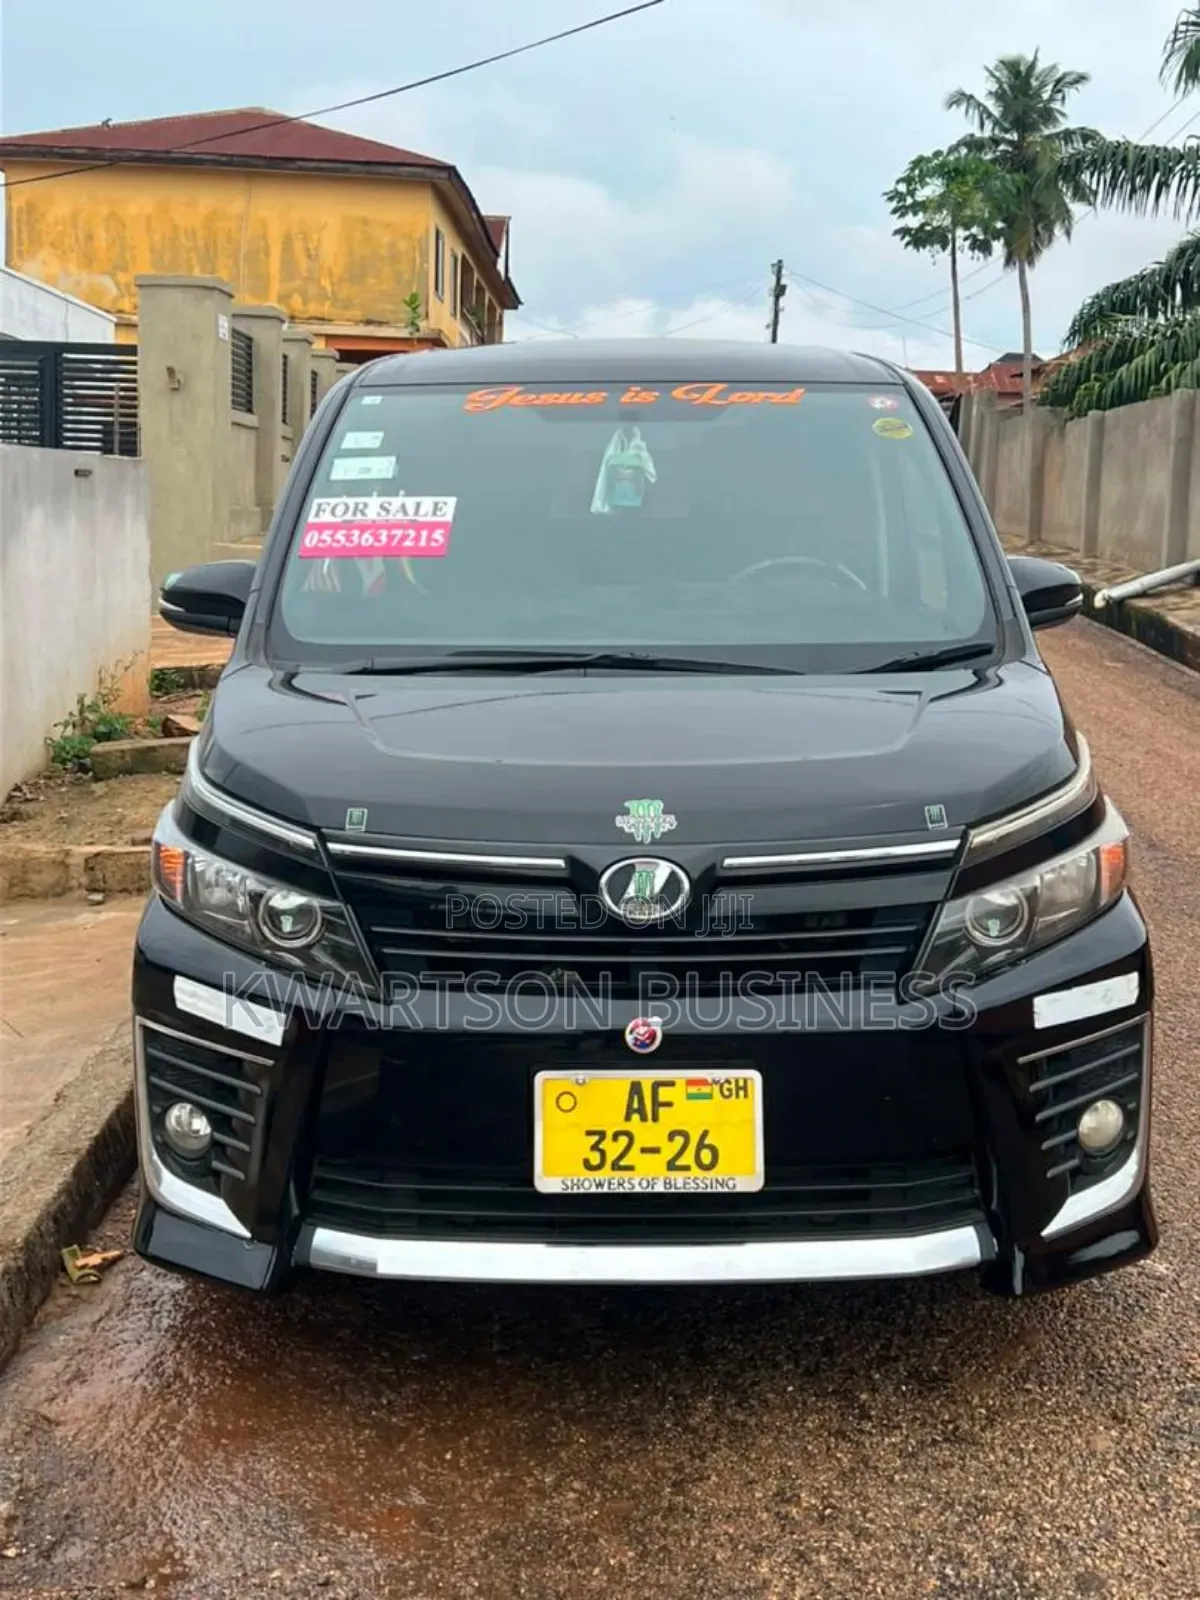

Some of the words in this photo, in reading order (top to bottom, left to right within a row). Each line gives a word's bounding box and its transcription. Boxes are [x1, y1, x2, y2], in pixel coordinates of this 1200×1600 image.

[464, 385, 608, 412] Jesus
[619, 386, 660, 404] is
[671, 383, 806, 405] Lord
[313, 501, 369, 519] FOR
[376, 501, 448, 518] SALE
[304, 529, 445, 548] 0553637215
[720, 1078, 749, 1100] GH
[624, 1080, 677, 1123] AF
[582, 1129, 720, 1172] 32-26
[561, 1177, 636, 1191] SHOWERS
[638, 1177, 659, 1191] OF
[663, 1177, 737, 1191] BLESSING
